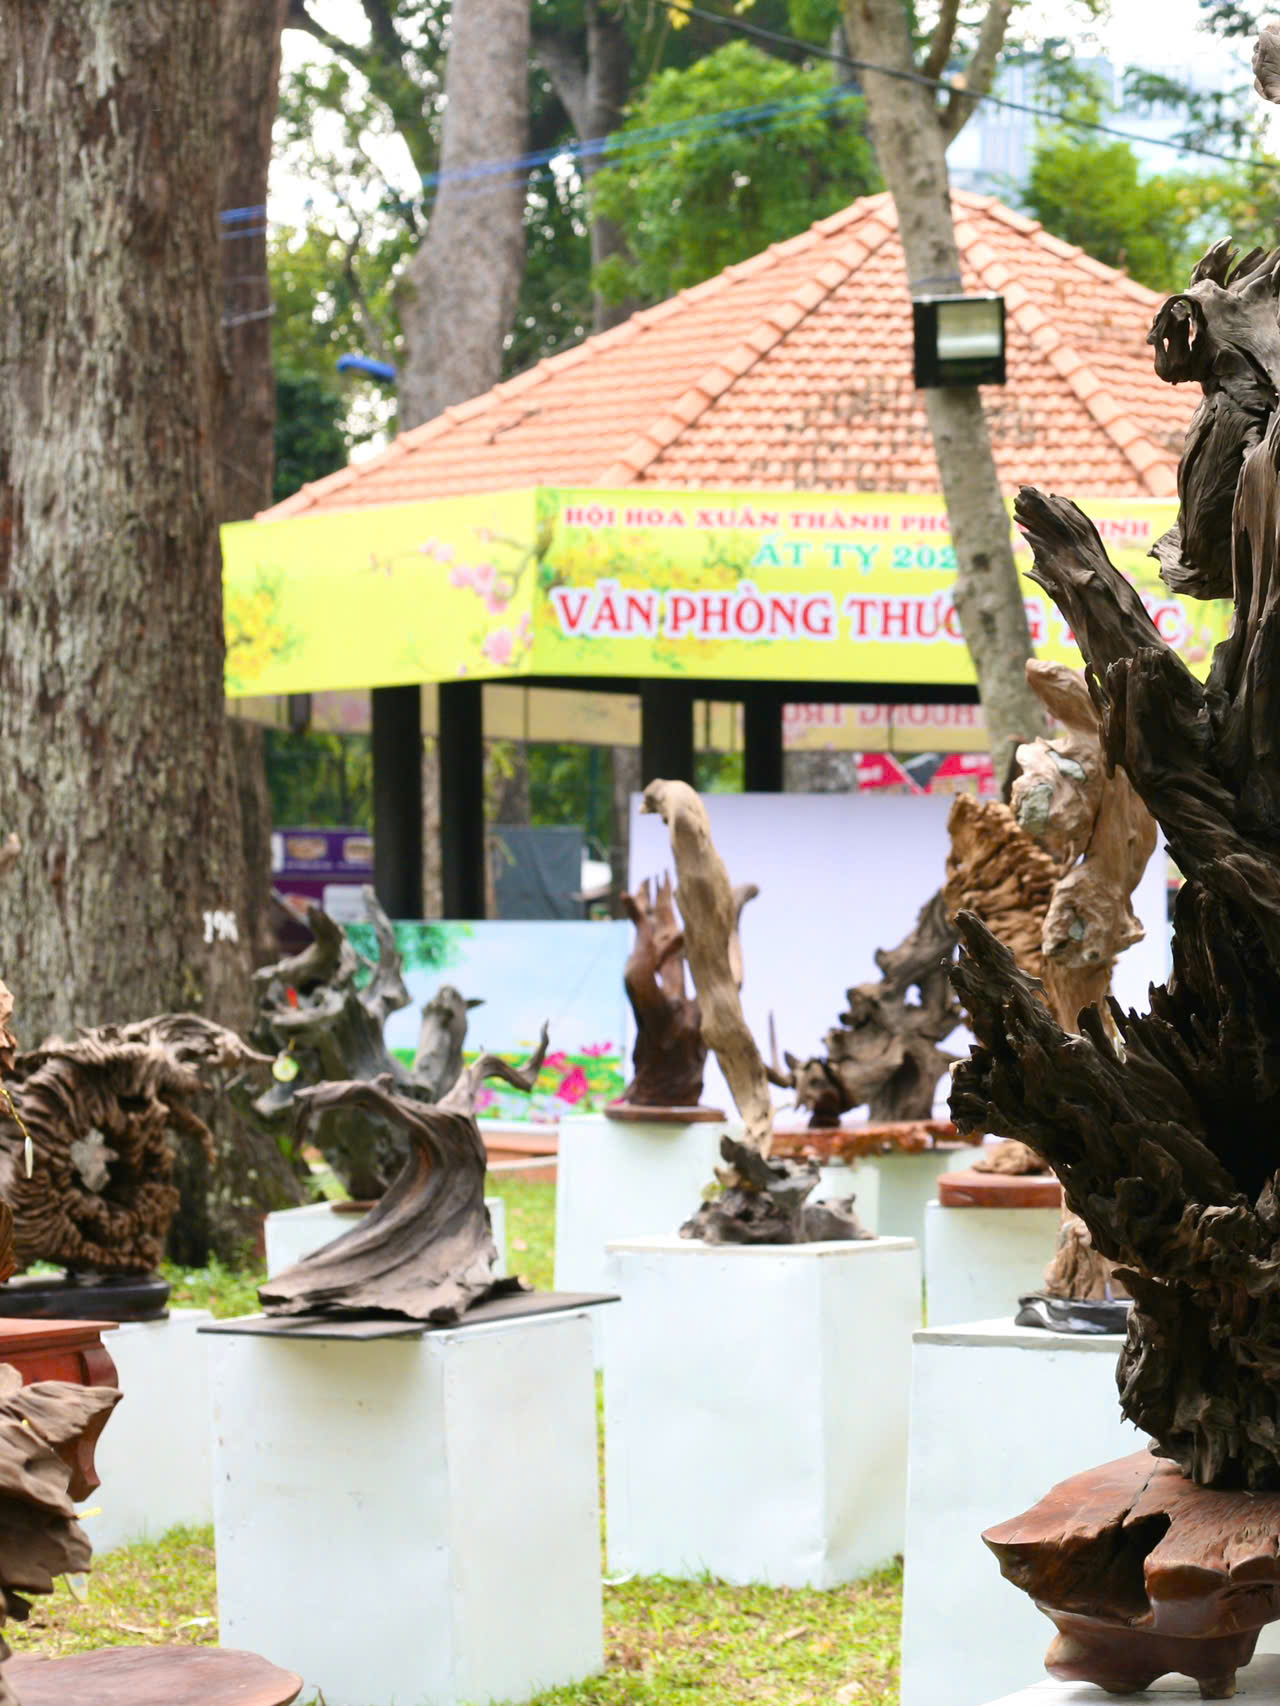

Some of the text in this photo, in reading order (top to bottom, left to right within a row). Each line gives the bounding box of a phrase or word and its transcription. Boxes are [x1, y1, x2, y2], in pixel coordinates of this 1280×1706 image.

[626, 508, 685, 526] HOA
[696, 503, 778, 527] XUÂN
[790, 508, 890, 531] THÀNH
[1095, 518, 1150, 536] INH
[893, 545, 957, 569] 202
[558, 585, 654, 632] VĂN
[670, 583, 832, 635] PHÒNG
